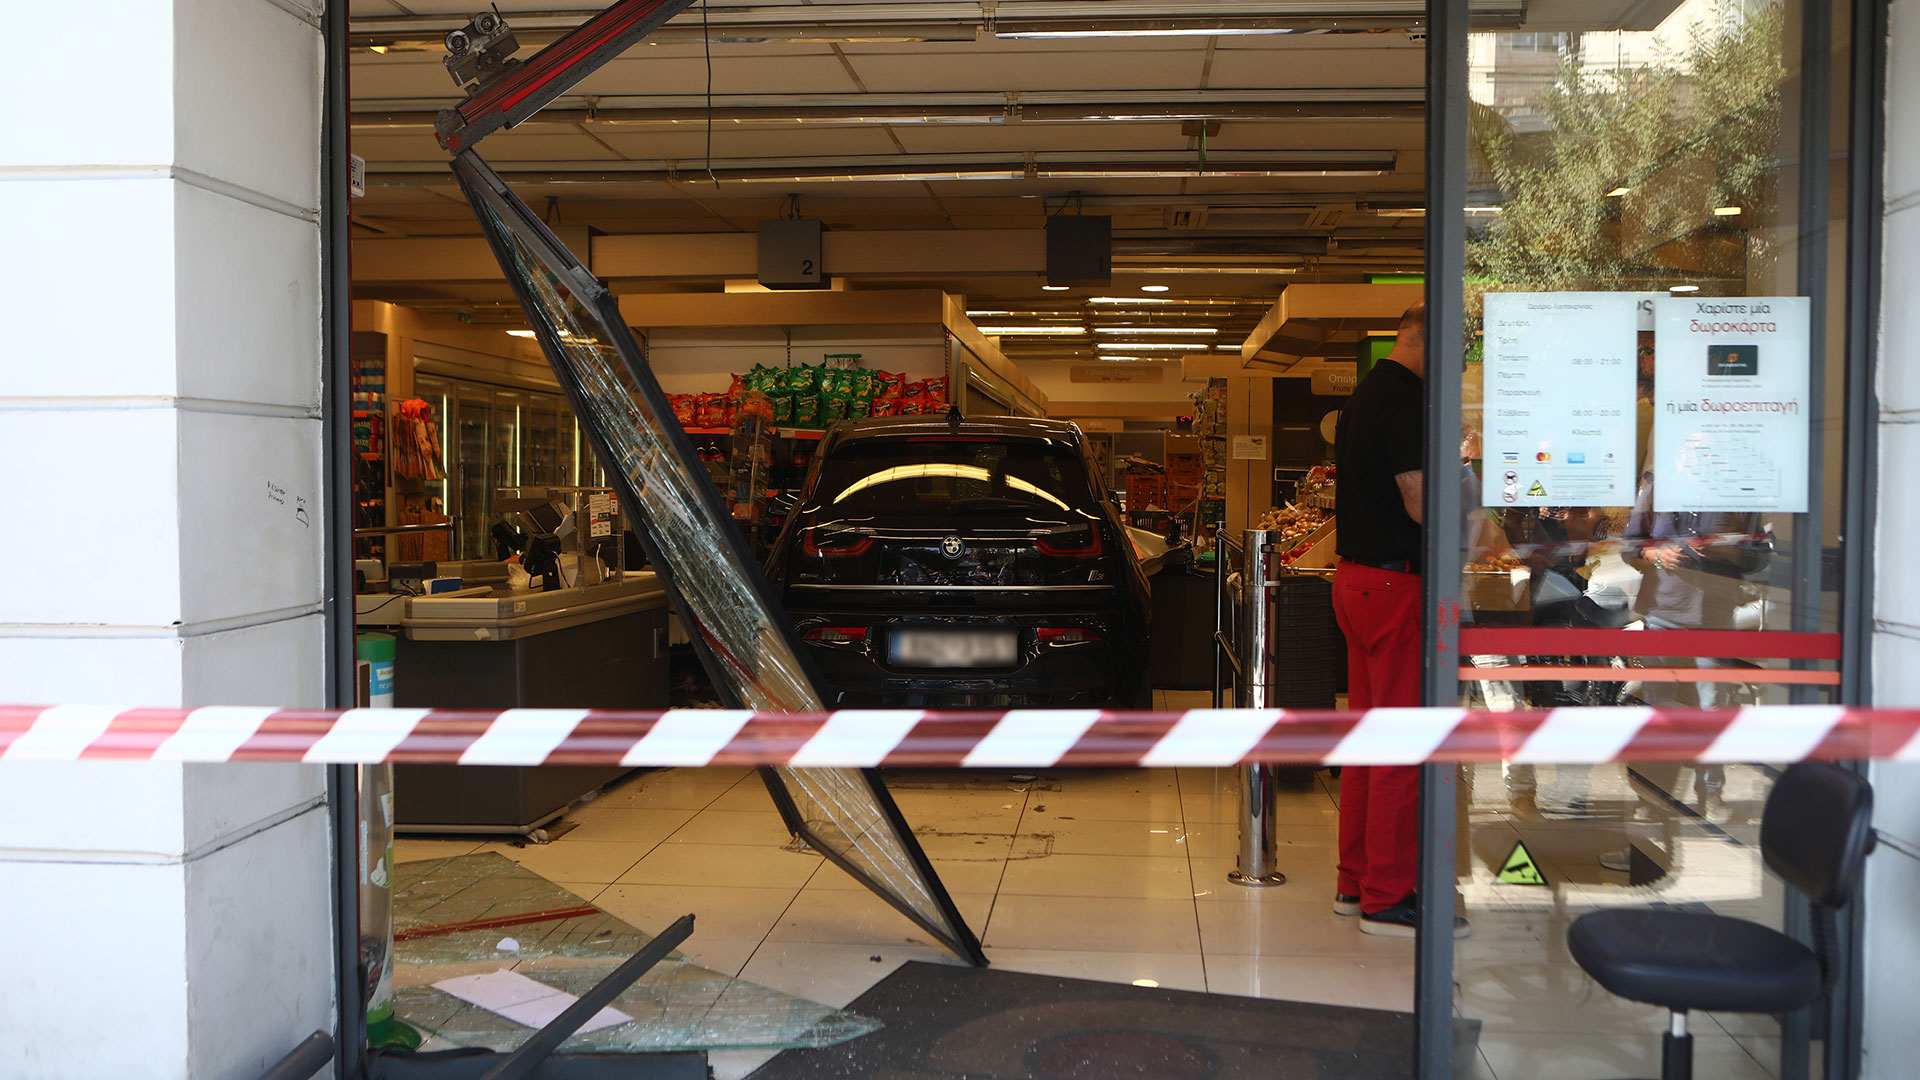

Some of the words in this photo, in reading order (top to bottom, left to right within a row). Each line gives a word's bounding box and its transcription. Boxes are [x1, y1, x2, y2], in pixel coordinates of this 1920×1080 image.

[801, 259, 814, 276] 2
[1696, 302, 1747, 315] Χαρίστε
[1750, 302, 1770, 315] μία
[1689, 319, 1777, 334] δωροκάρτα
[1666, 400, 1675, 414] ή
[1678, 400, 1698, 414] μία
[1701, 398, 1799, 415] δωροεπιταγή
